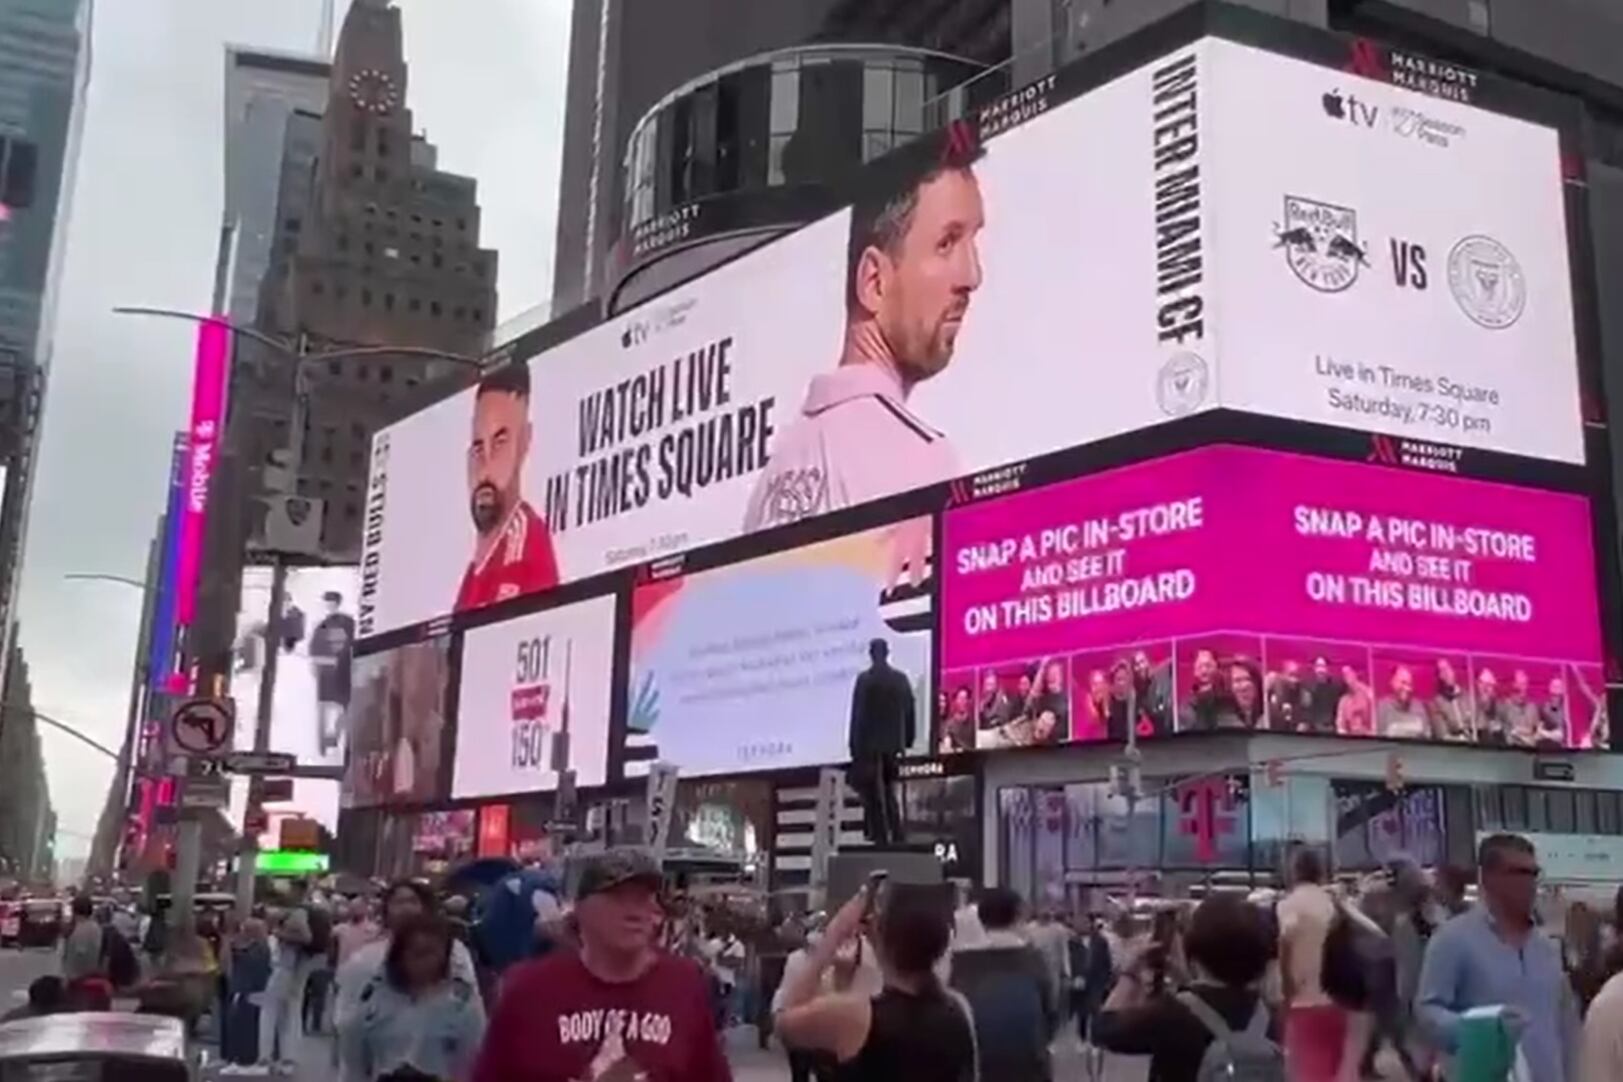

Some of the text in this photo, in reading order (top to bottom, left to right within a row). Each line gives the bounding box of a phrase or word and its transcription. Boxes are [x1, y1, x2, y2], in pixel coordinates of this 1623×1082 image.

[1391, 52, 1478, 88] MARRIOTT
[1392, 70, 1470, 101] MARQUIS
[980, 75, 1056, 124] MARRIOTT
[980, 97, 1048, 138] MARQUIS
[1347, 95, 1379, 129] tv
[634, 203, 699, 240] MARRIOTT
[1152, 54, 1205, 343] INTER MIAMI CF
[1390, 236, 1428, 291] VS
[578, 335, 733, 460] WATCH LIVE
[1315, 354, 1500, 407] Live in Times Square
[1463, 415, 1492, 434] pm
[546, 396, 775, 532] IN TIMES SQUARE
[1401, 441, 1463, 461] MARRIOTT
[957, 496, 1203, 574] SNAP A PIC IN-STORE
[1294, 505, 1537, 562] SNAP A PIC IN-STORE
[362, 551, 380, 598] RED
[1020, 549, 1127, 591] AND SEE IT
[1369, 548, 1473, 582] AND SEE IT
[964, 569, 1196, 634] ON THIS BILLBOARD
[1306, 571, 1532, 622] ON THIS BILLBOARD
[516, 635, 550, 684] 501
[511, 723, 543, 768] 150
[558, 1008, 604, 1043] BODY
[626, 1010, 638, 1039] A
[640, 1011, 672, 1044] GOD
